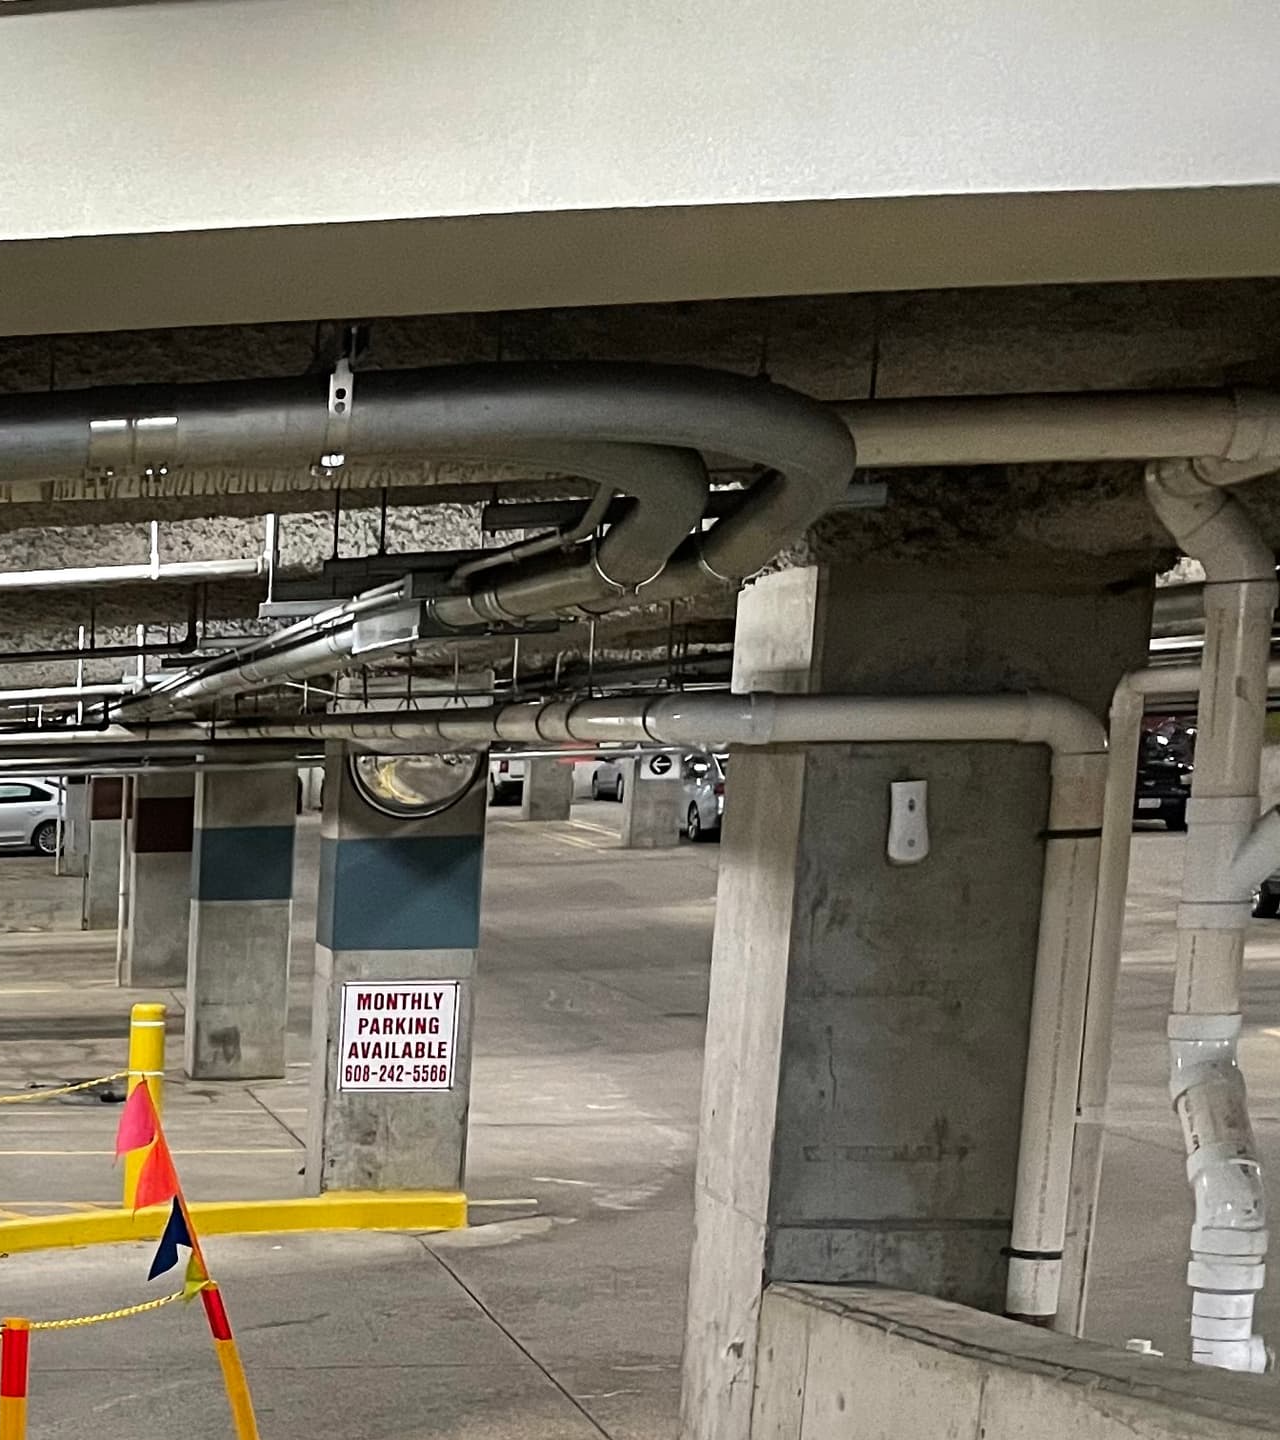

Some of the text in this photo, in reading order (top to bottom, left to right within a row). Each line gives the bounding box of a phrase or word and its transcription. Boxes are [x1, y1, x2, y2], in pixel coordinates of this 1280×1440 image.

[357, 992, 444, 1011] MONTHLY
[358, 1017, 439, 1035] PARKING
[347, 1042, 448, 1059] AVAILABLE
[345, 1065, 447, 1082] 608-242-5586
